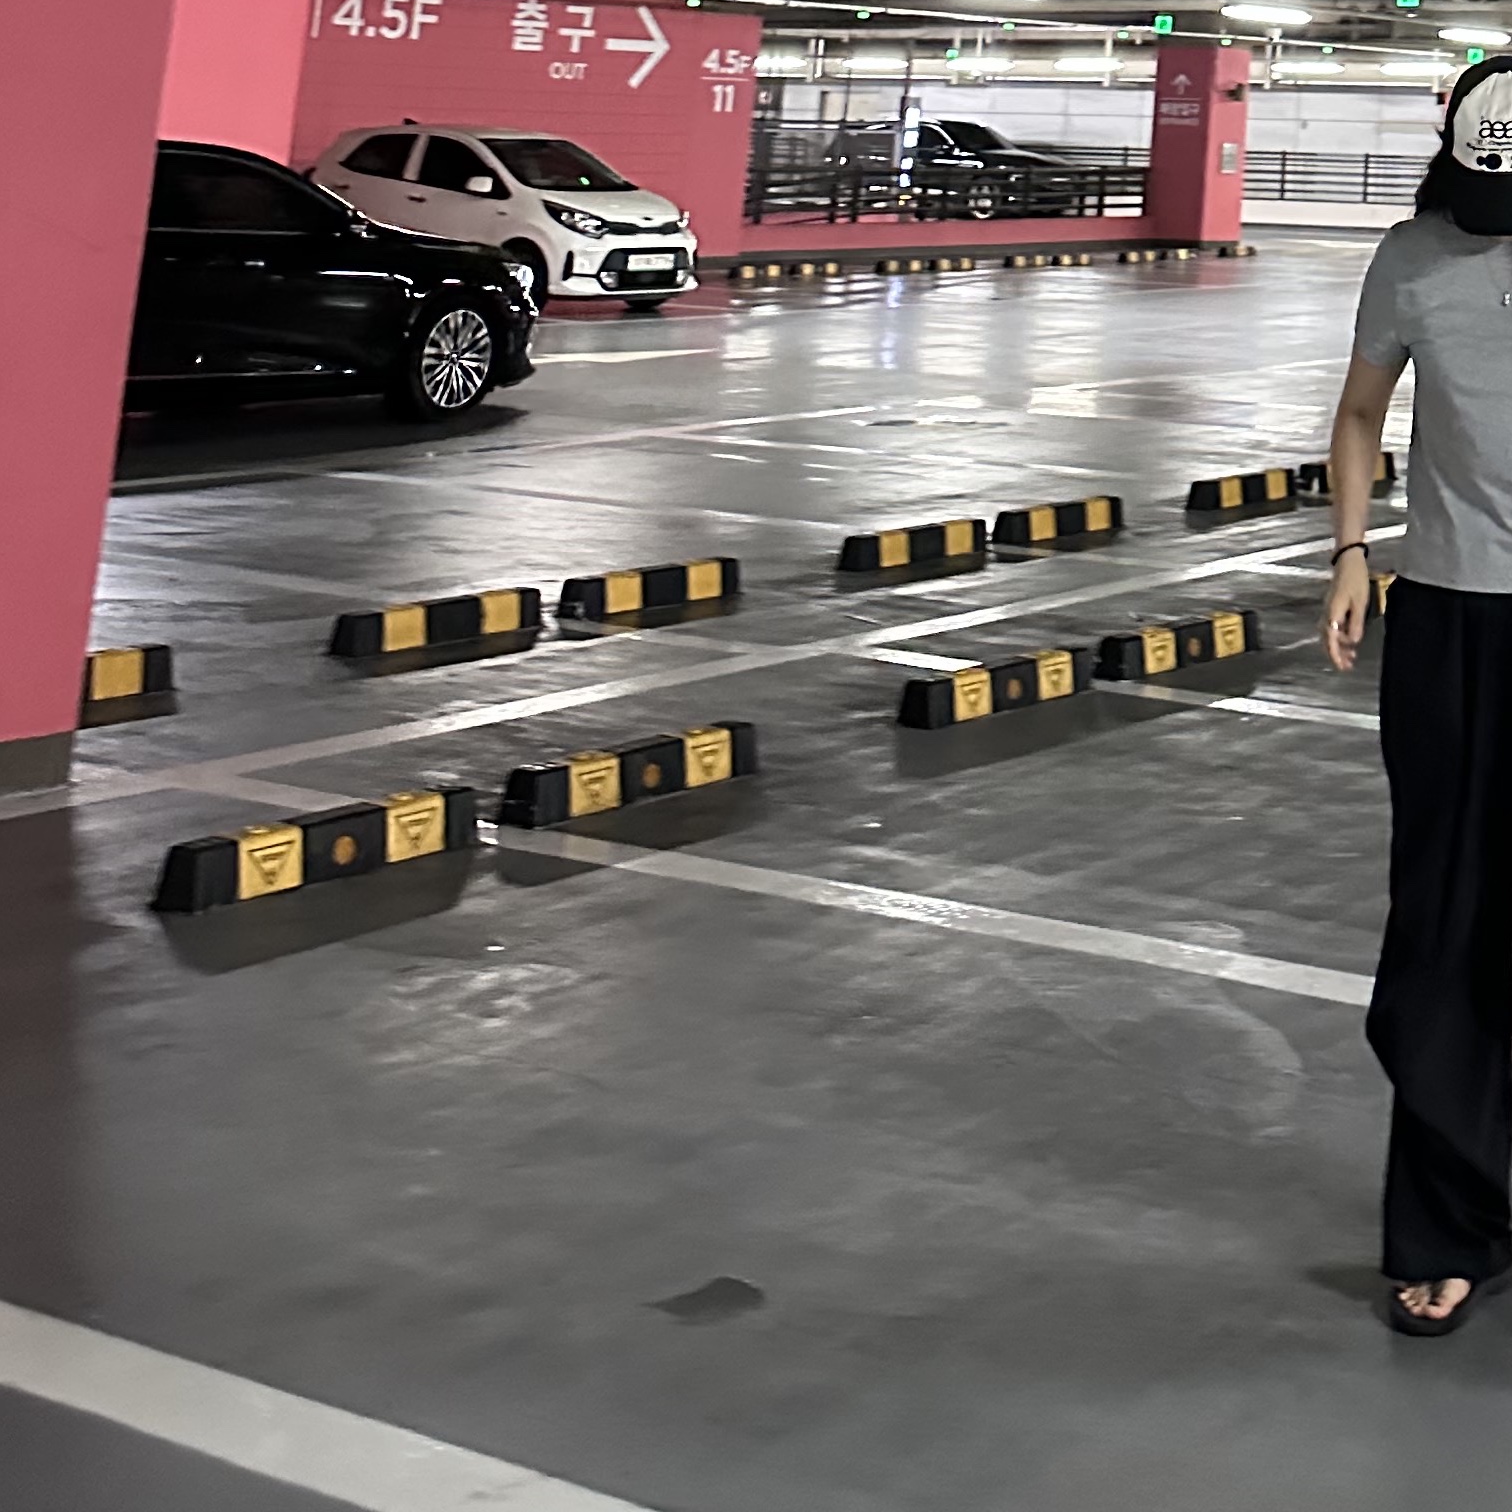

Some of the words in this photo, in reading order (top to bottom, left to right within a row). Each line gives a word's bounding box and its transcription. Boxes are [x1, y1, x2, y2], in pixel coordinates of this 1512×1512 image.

[510, 0, 596, 53] 출구
[549, 62, 588, 80] OUT
[702, 48, 752, 74] 4.5F
[711, 84, 735, 112] 11
